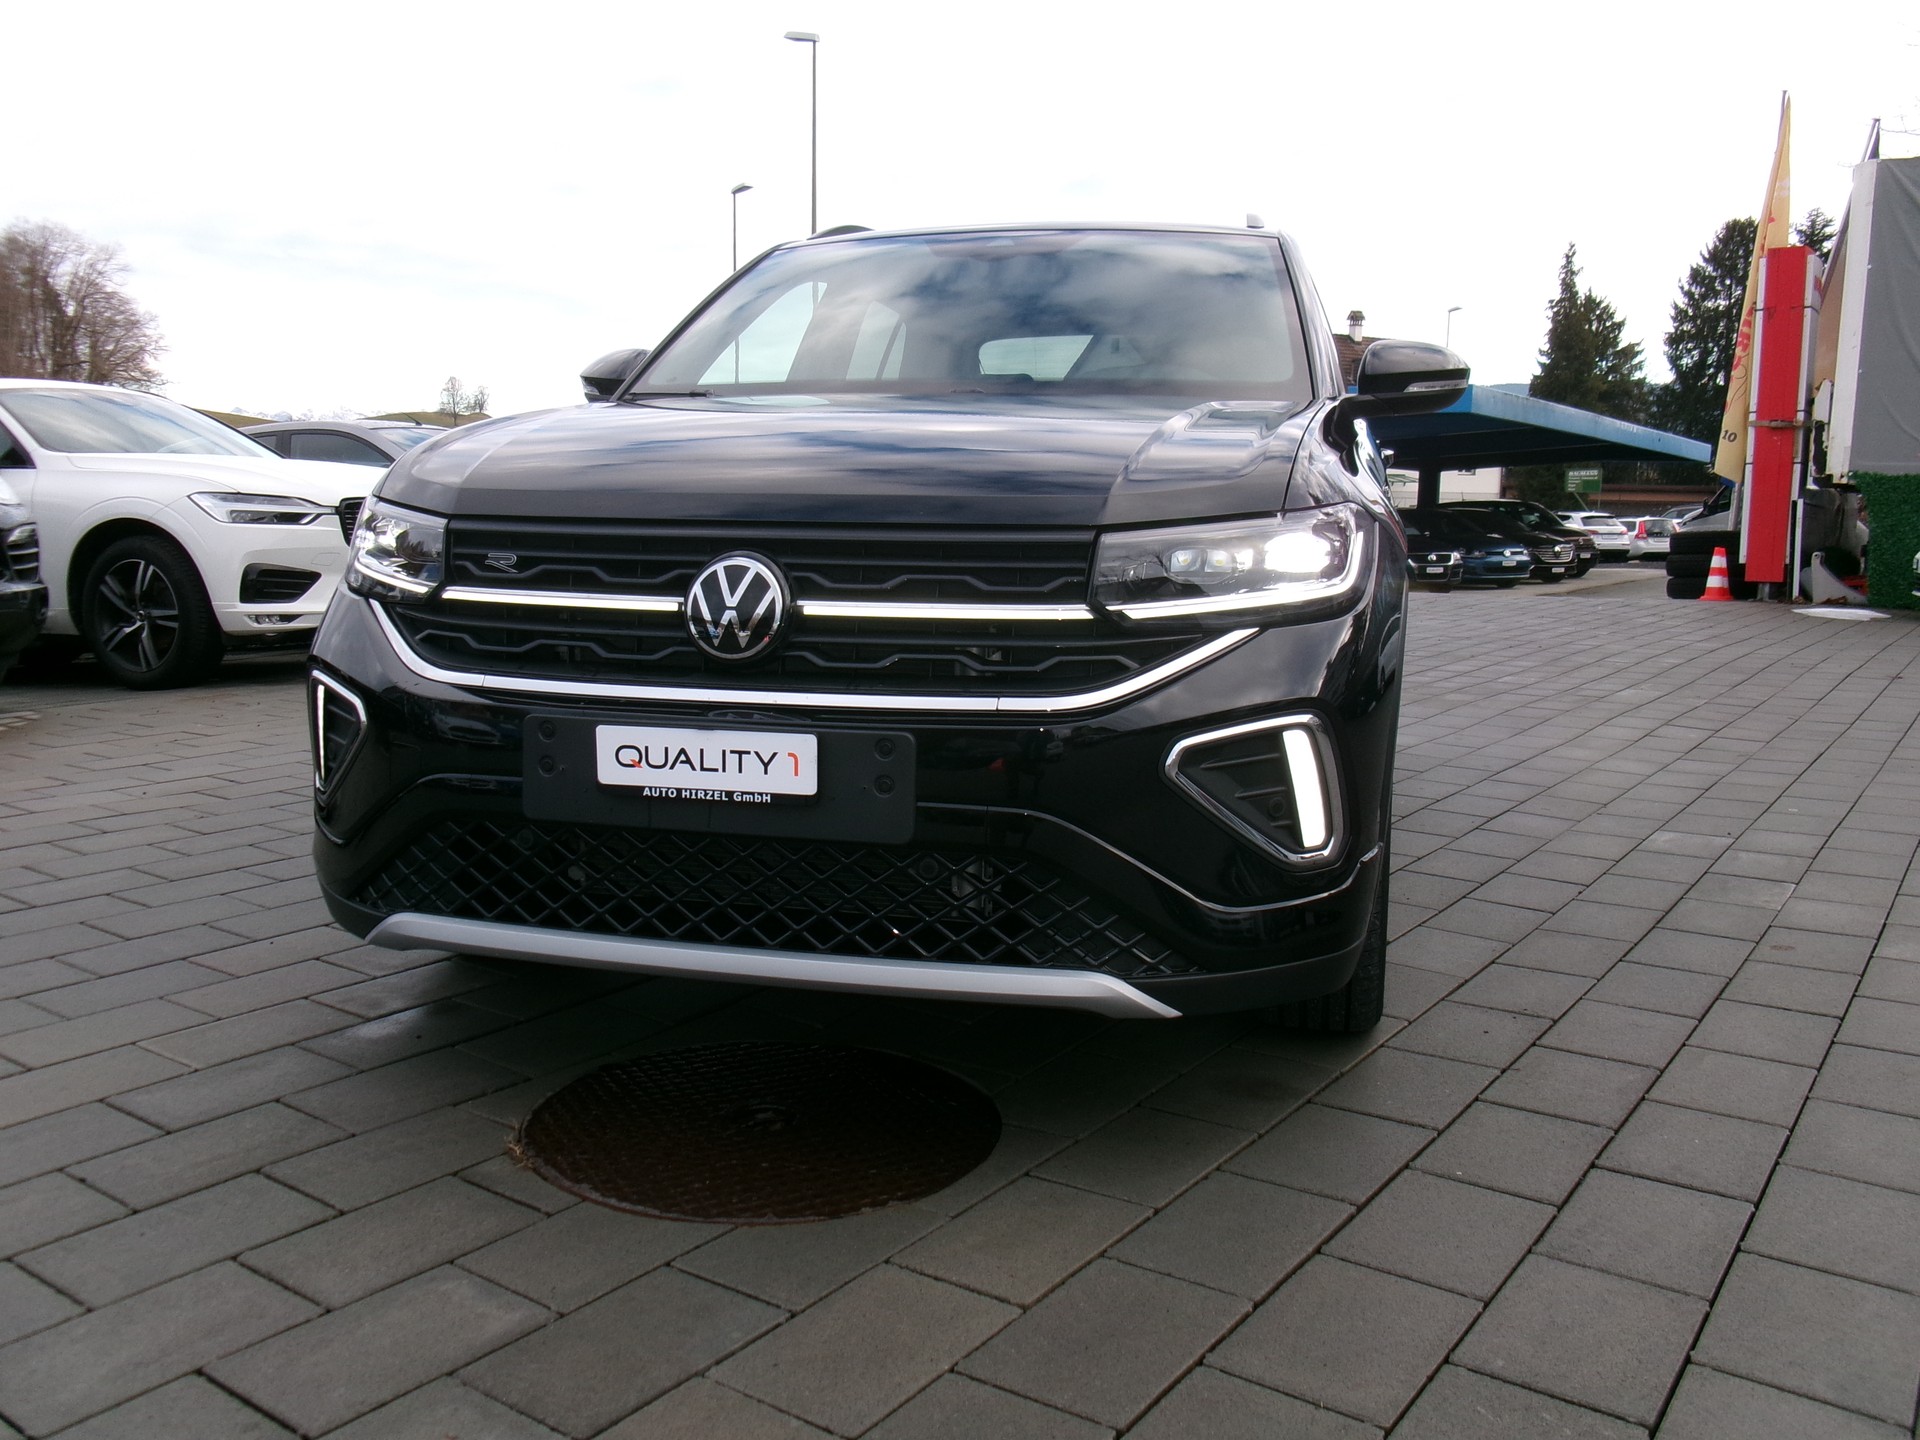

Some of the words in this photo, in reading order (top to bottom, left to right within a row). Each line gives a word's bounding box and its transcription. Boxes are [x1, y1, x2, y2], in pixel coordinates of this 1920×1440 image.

[1722, 430, 1738, 443] 10
[643, 787, 677, 798] AUTO
[682, 788, 728, 801] HIRZEL
[733, 792, 771, 803] GmbH
